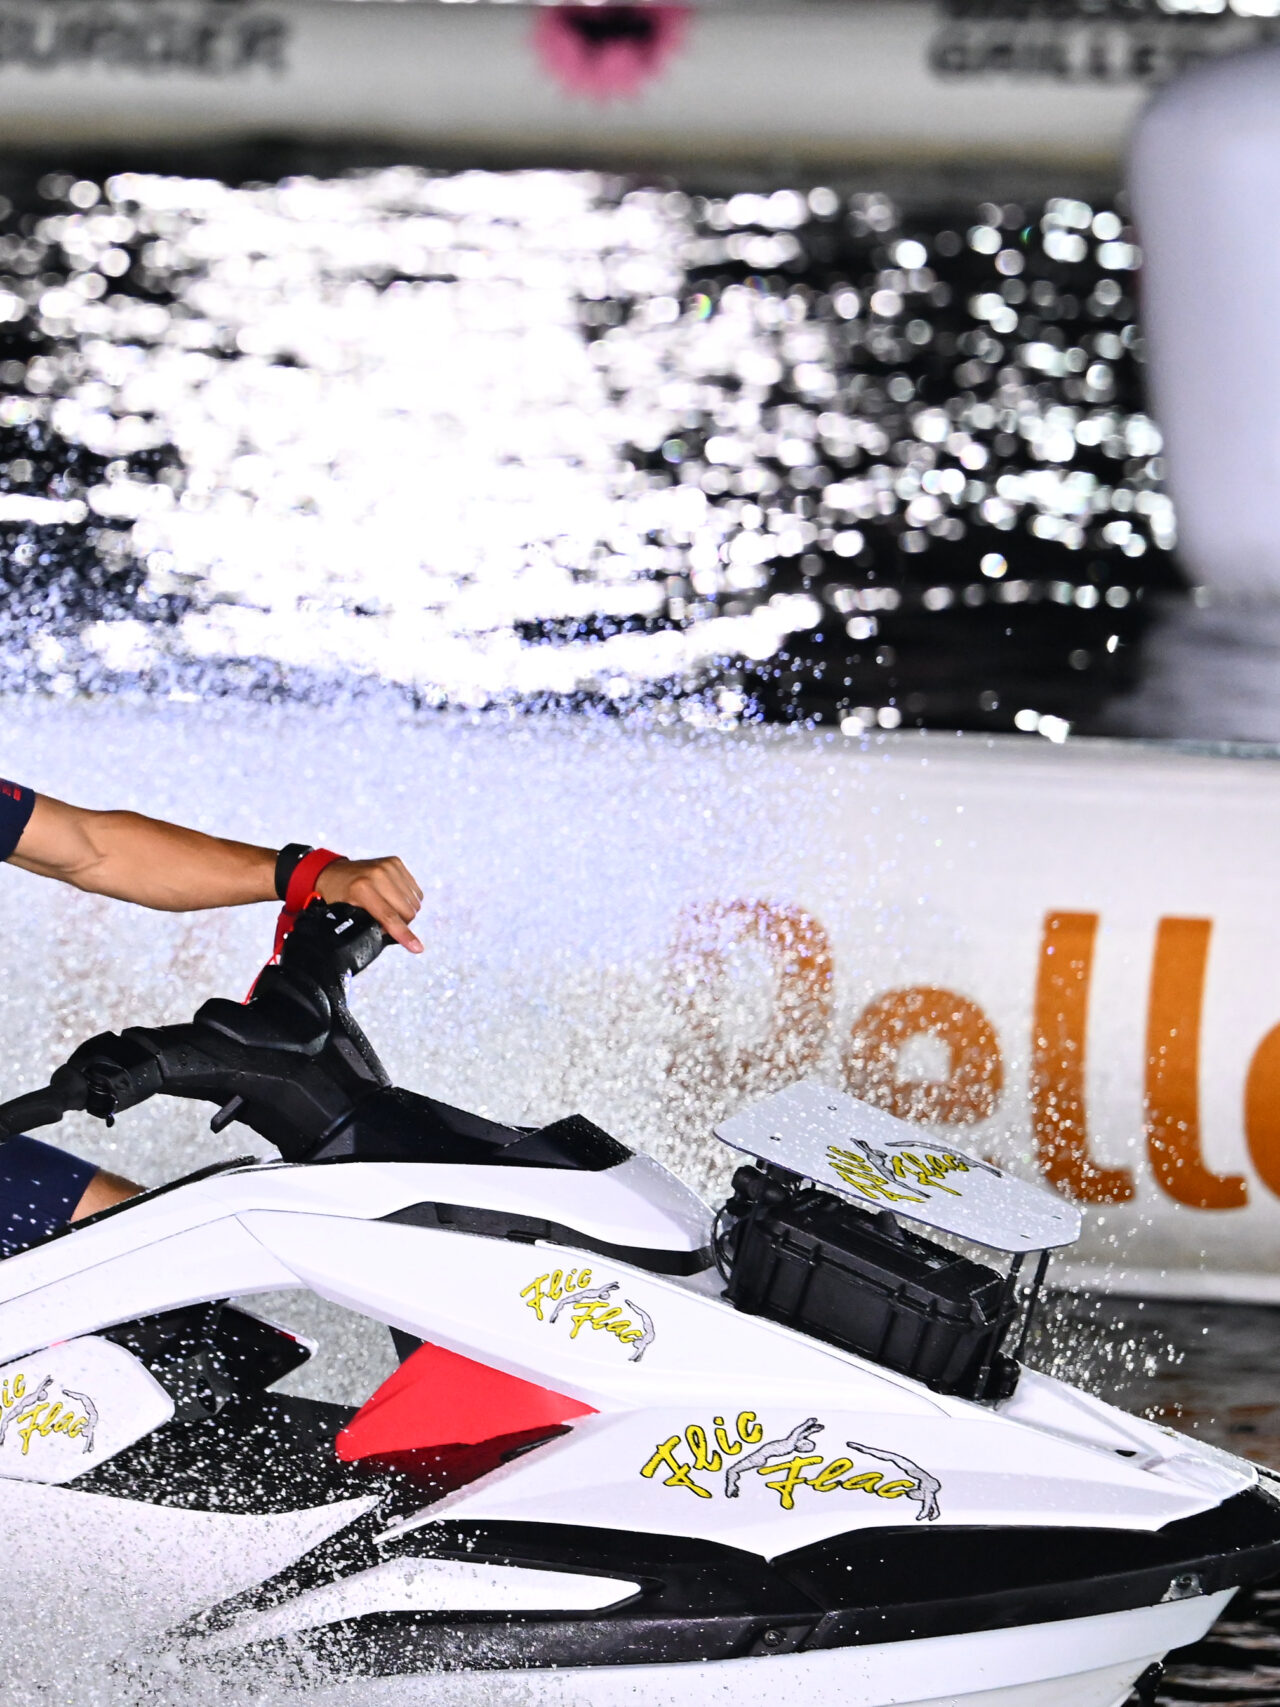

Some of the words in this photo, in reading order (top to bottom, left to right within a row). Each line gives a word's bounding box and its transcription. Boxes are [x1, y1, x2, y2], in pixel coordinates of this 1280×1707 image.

[663, 898, 1280, 1212] Pell
[890, 1151, 970, 1197] Flac
[520, 1268, 592, 1321] Flic
[570, 1301, 643, 1343] Flac
[17, 1402, 88, 1455] Flac
[640, 1411, 763, 1498] Flic
[757, 1456, 916, 1510] Flac
